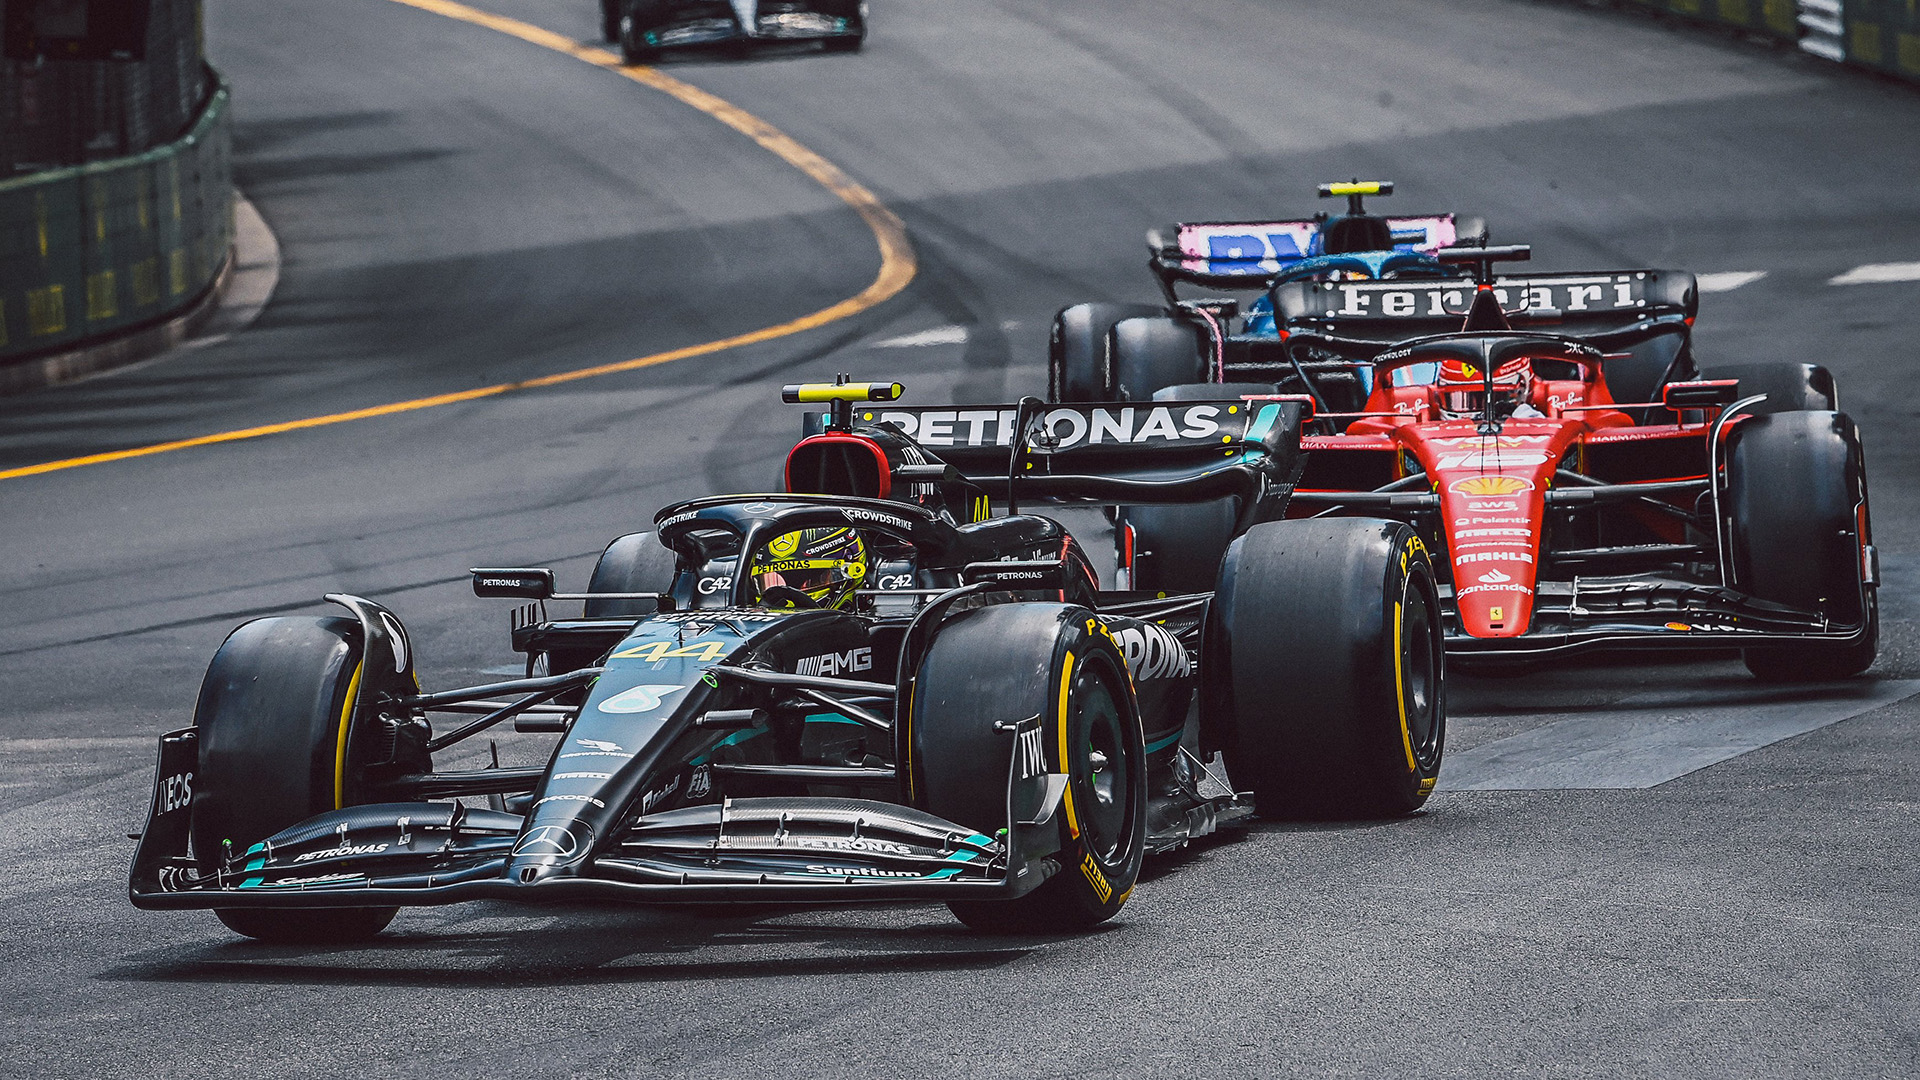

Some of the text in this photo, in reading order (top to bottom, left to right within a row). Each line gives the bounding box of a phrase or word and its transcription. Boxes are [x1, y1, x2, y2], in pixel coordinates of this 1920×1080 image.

[847, 509, 913, 531] CROWDSTRIKE
[758, 560, 811, 574] PETRONAS
[1456, 552, 1533, 567] MAHLE
[483, 578, 521, 588] PETRONAS
[997, 571, 1043, 580] PETRONAS
[1457, 583, 1533, 600] Santander
[607, 641, 728, 662] 44
[818, 646, 872, 677] AMG
[157, 772, 194, 817] INEOS
[293, 843, 389, 862] PETRONAS
[799, 837, 912, 855] PETRONAS
